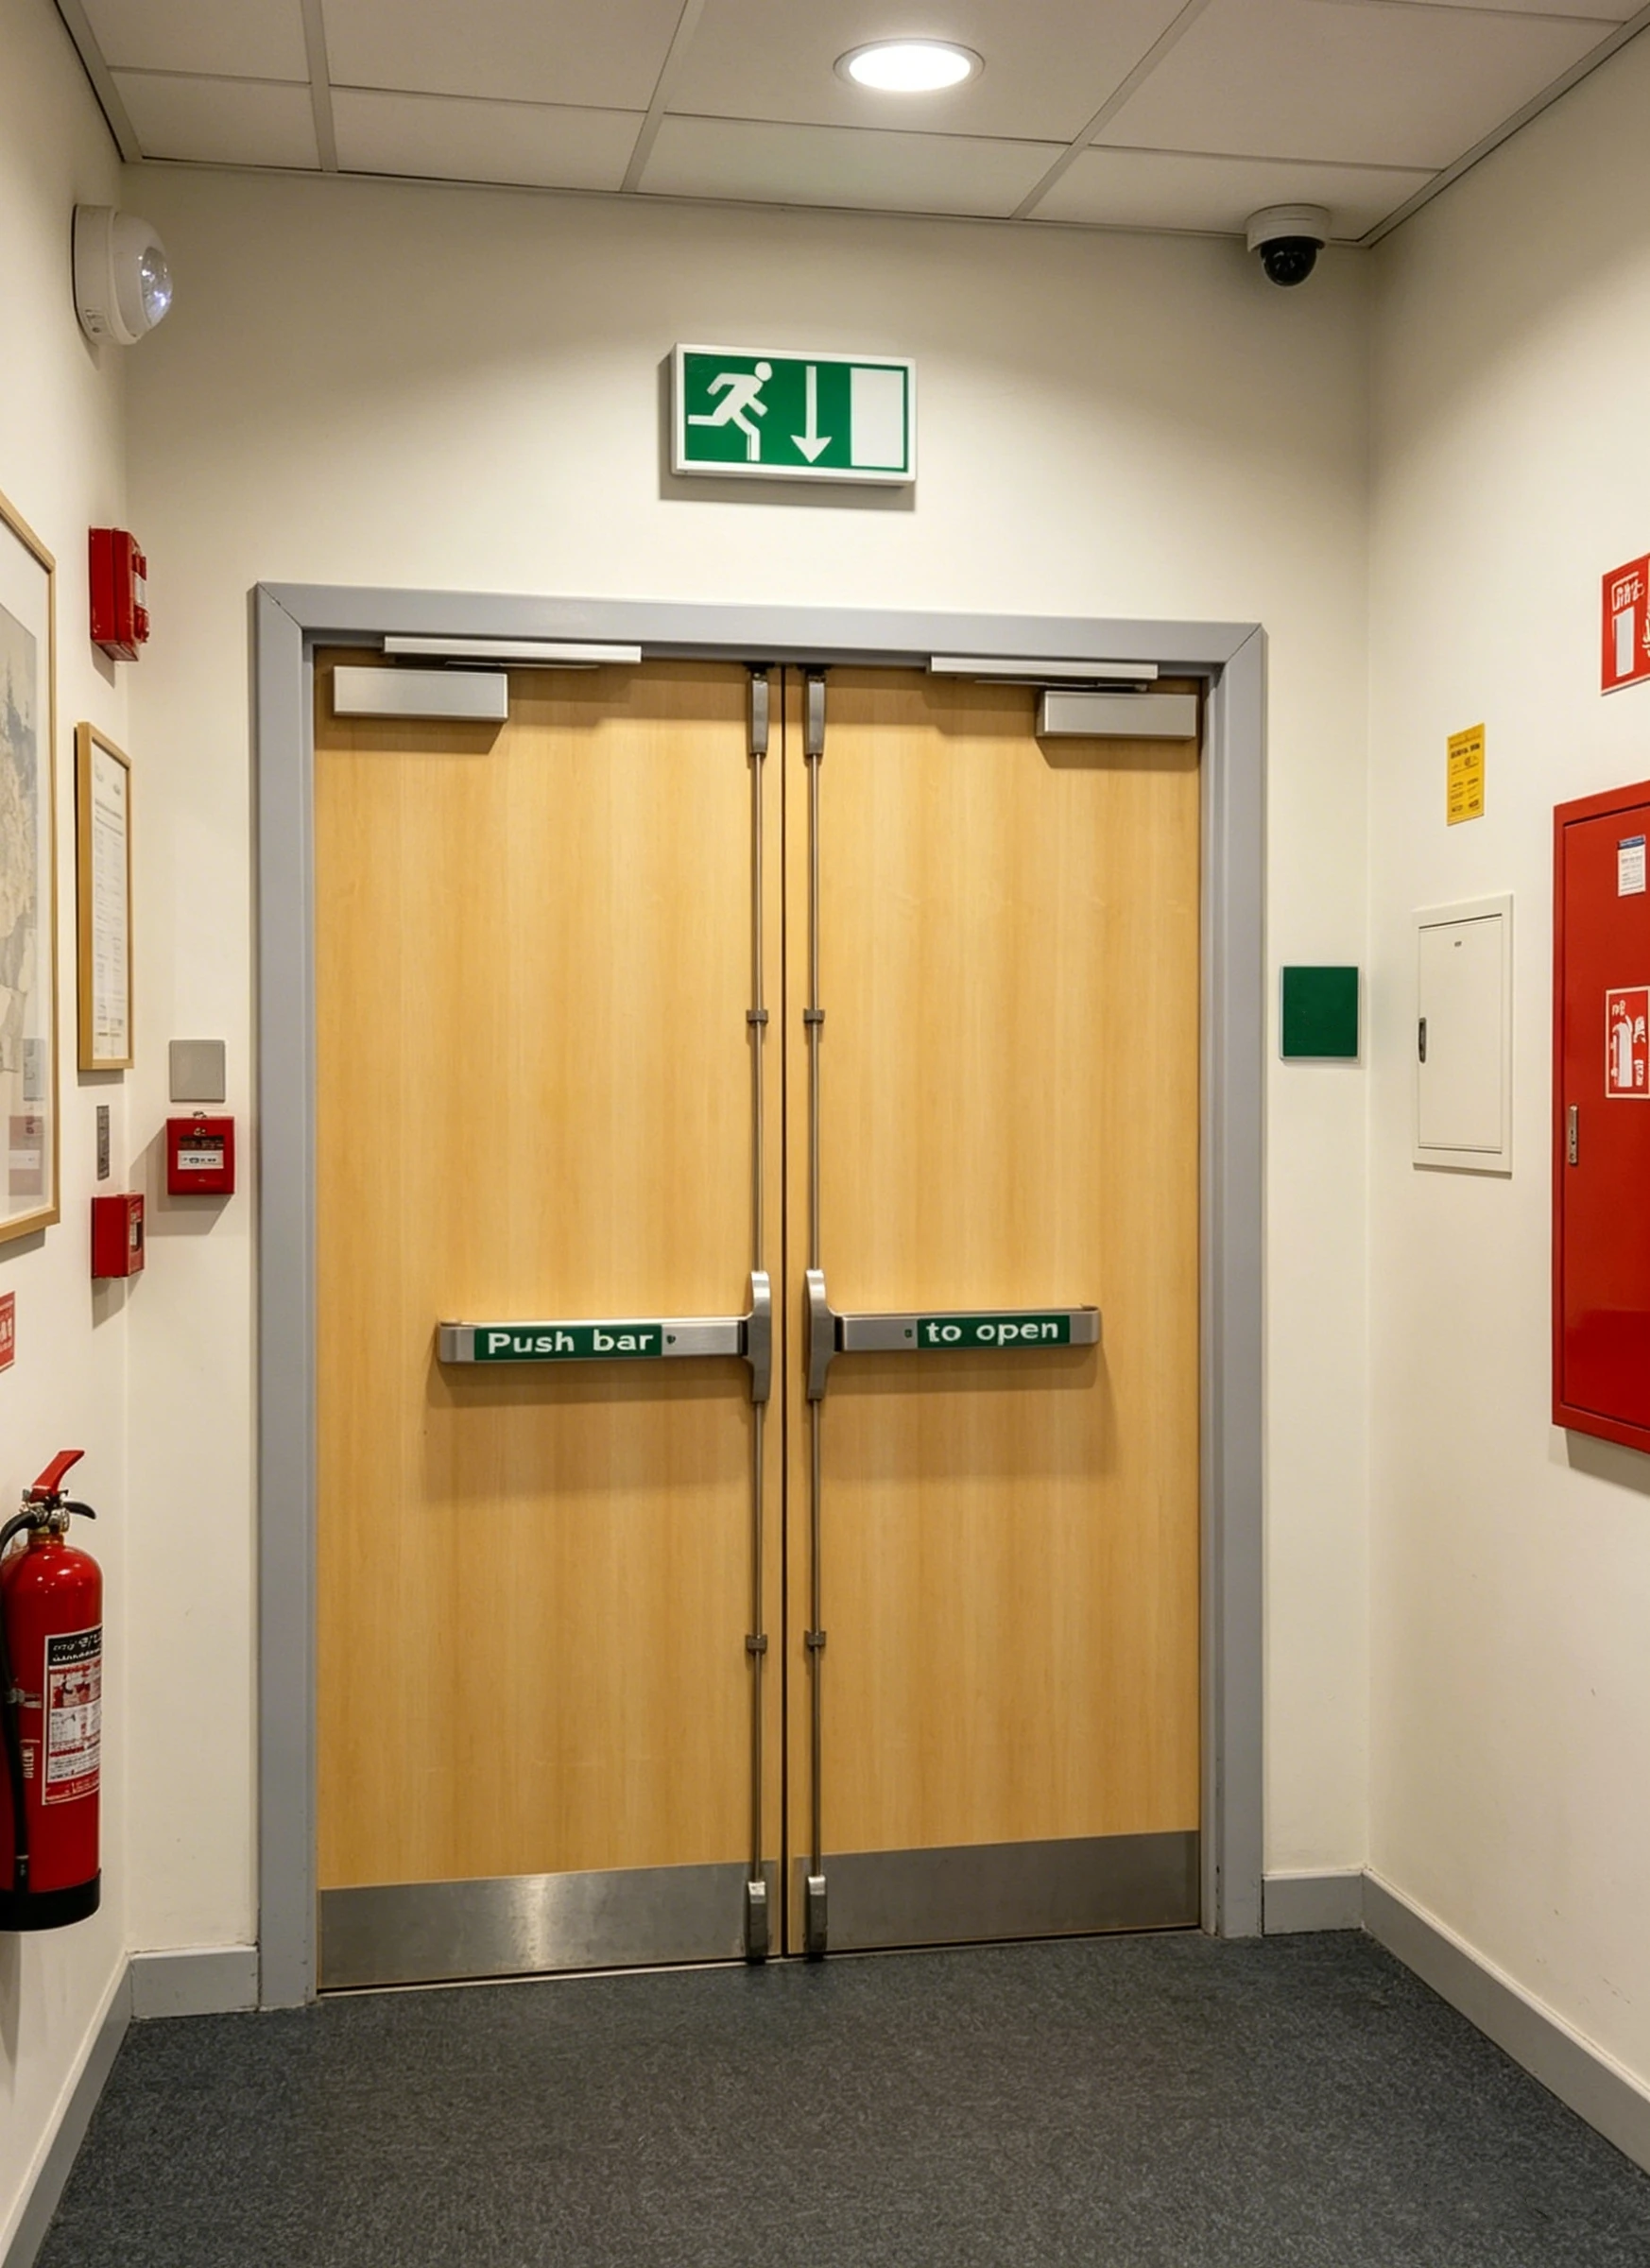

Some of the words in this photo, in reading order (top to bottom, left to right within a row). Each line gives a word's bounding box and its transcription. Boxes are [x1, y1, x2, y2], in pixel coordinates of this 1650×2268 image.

[488, 1331, 575, 1354] Push
[593, 1329, 654, 1351] bar
[926, 1321, 962, 1343] to
[975, 1322, 1058, 1346] open
